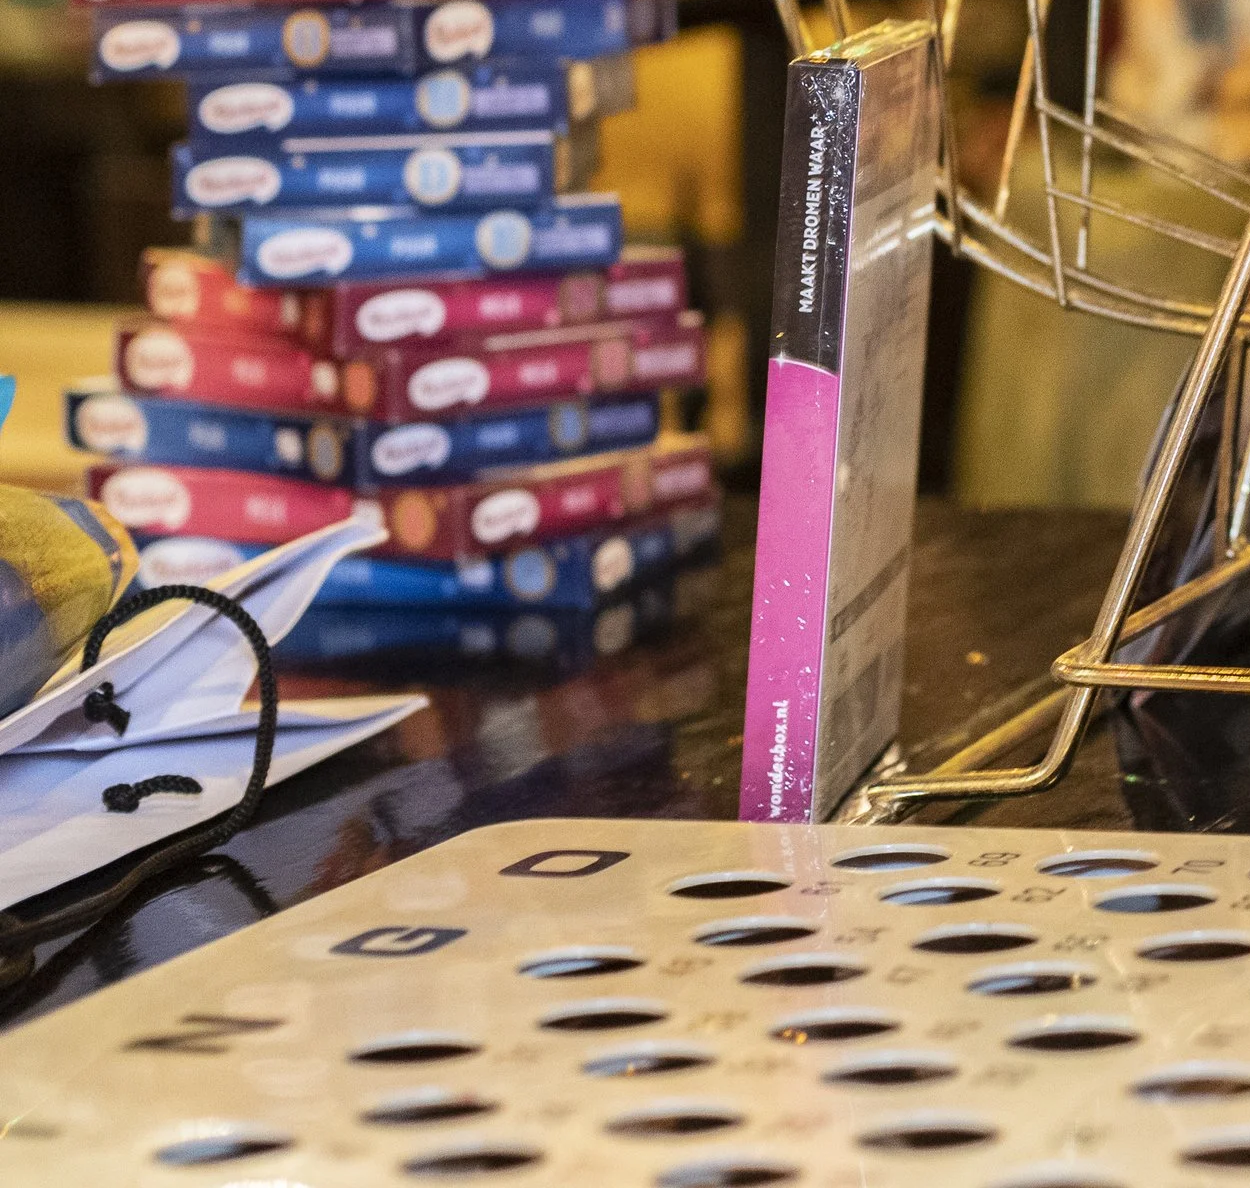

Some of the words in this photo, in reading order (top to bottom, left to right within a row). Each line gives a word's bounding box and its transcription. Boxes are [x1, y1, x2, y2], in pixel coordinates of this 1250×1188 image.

[807, 125, 828, 178] WAAR
[801, 181, 823, 250] DROMEN
[797, 249, 818, 314] MAAKT
[767, 698, 790, 819] wonderbox.nl
[968, 851, 1020, 868] 69
[1171, 859, 1226, 875] 70
